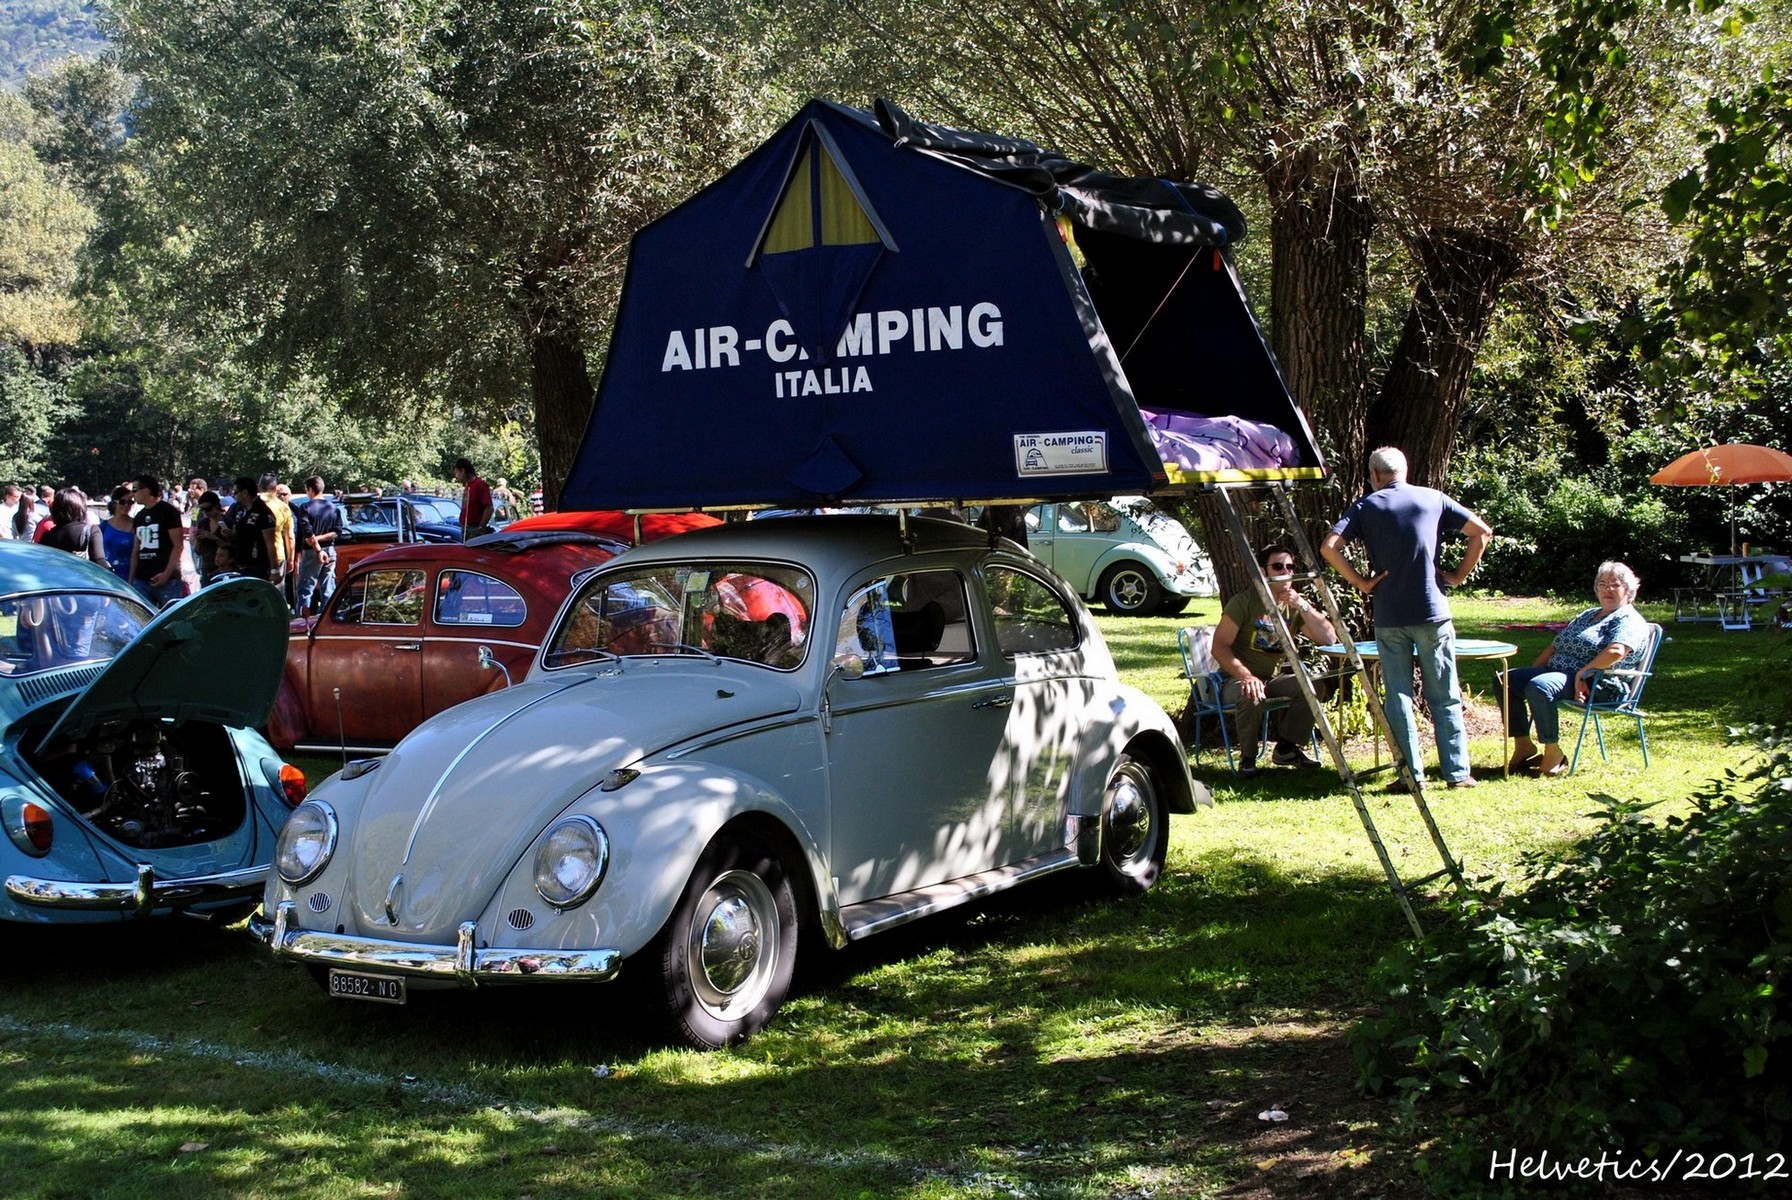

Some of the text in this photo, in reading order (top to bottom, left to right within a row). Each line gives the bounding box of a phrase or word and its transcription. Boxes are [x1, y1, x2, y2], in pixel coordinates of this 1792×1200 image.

[661, 301, 1004, 373] AIR-CMPING
[775, 365, 873, 398] ITALIA
[1020, 438, 1037, 448] AIR
[1044, 435, 1094, 447] CAMPING
[1071, 446, 1094, 454] classic
